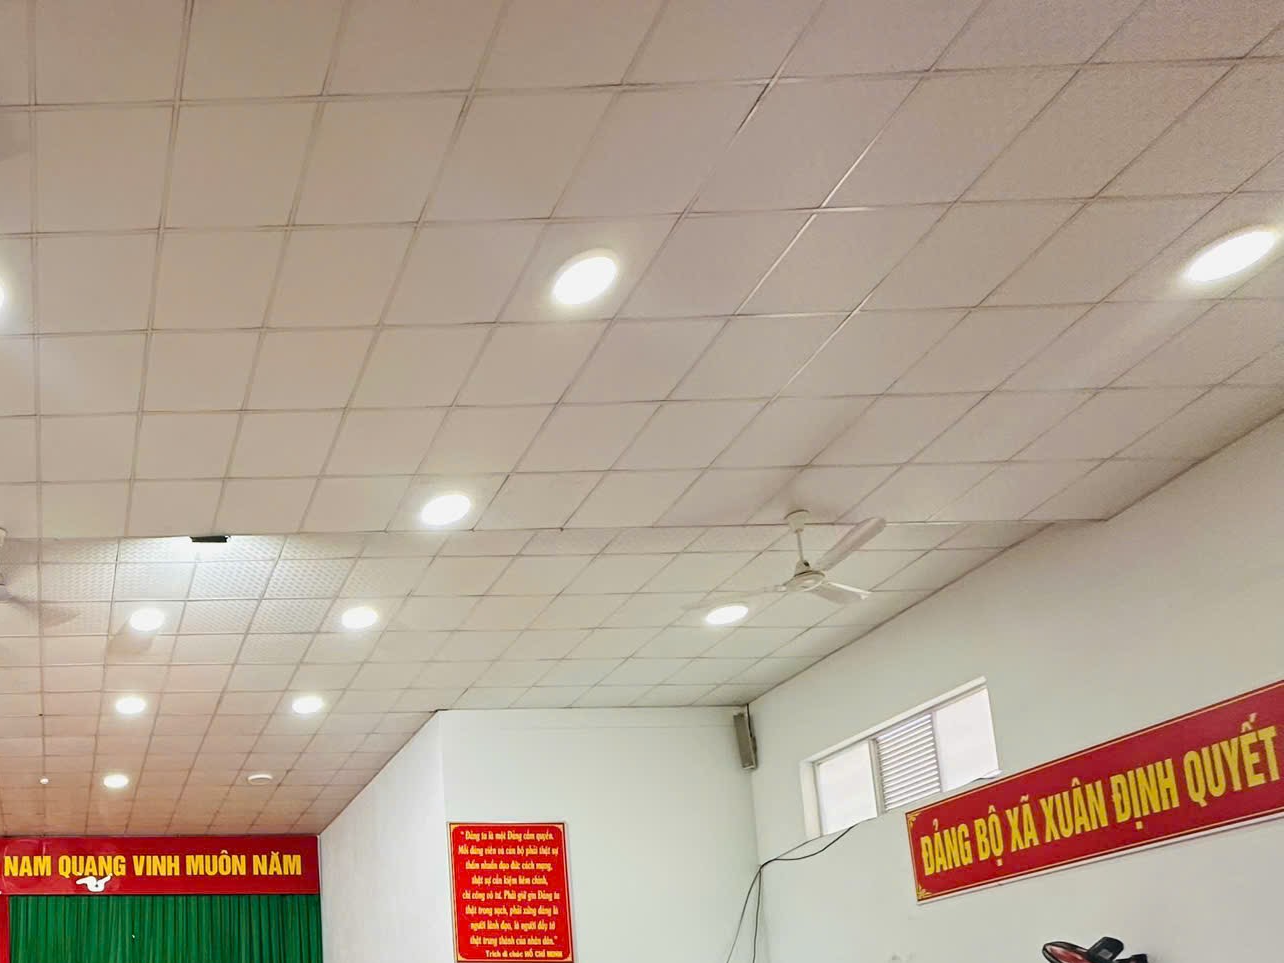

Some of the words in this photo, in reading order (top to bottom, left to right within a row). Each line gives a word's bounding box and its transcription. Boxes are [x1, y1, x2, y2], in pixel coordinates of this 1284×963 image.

[920, 818, 974, 876] ĐẢNG
[973, 804, 1005, 866] BỘ
[1005, 794, 1040, 854] XÃ
[1039, 777, 1109, 843] XUÂN
[1109, 758, 1180, 830] ĐỊNH
[1183, 712, 1281, 808] QUYẾT
[4, 855, 52, 876] NAM
[58, 855, 126, 878] QUANG
[132, 854, 180, 876] VINH
[186, 850, 246, 876] MUÔN
[253, 850, 302, 876] NĂM
